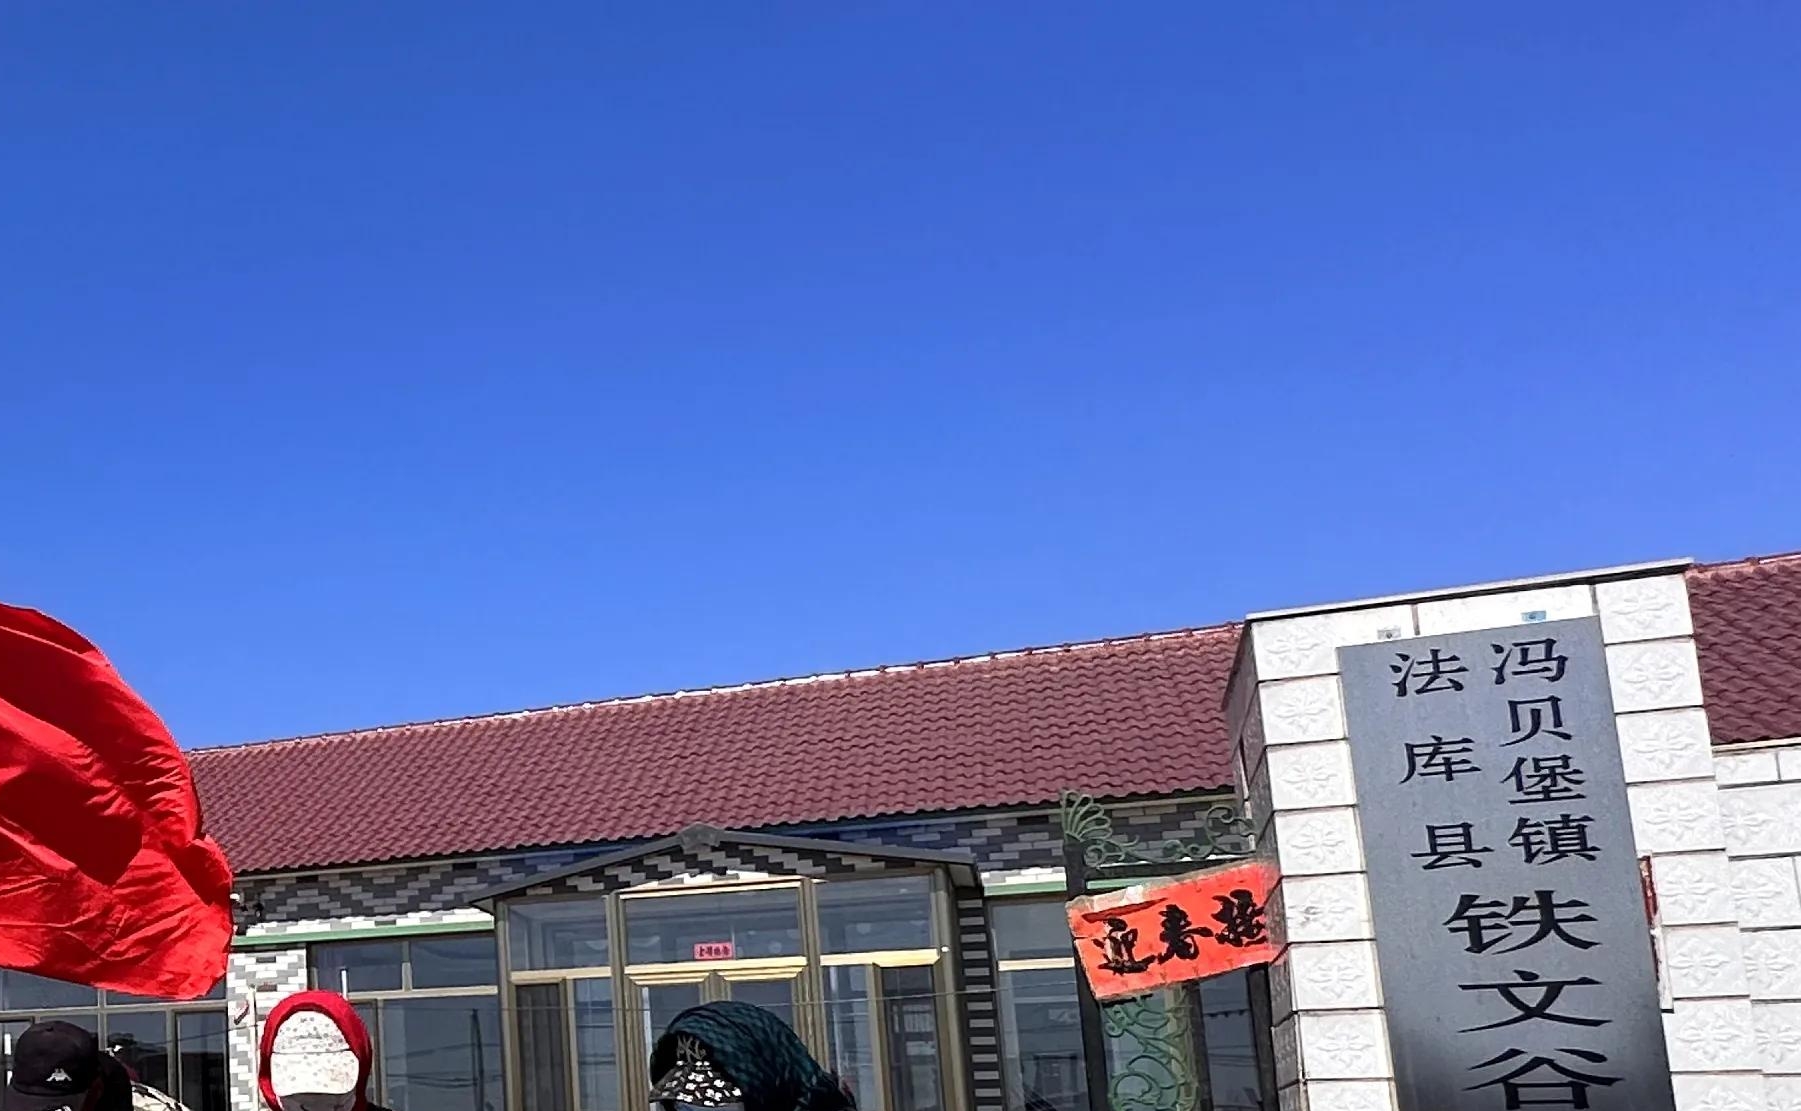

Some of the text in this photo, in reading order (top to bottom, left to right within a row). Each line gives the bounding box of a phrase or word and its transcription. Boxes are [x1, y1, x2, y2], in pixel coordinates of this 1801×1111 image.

[1389, 649, 1495, 870] 法库县
[1491, 638, 1602, 865] 冯贝堡镇
